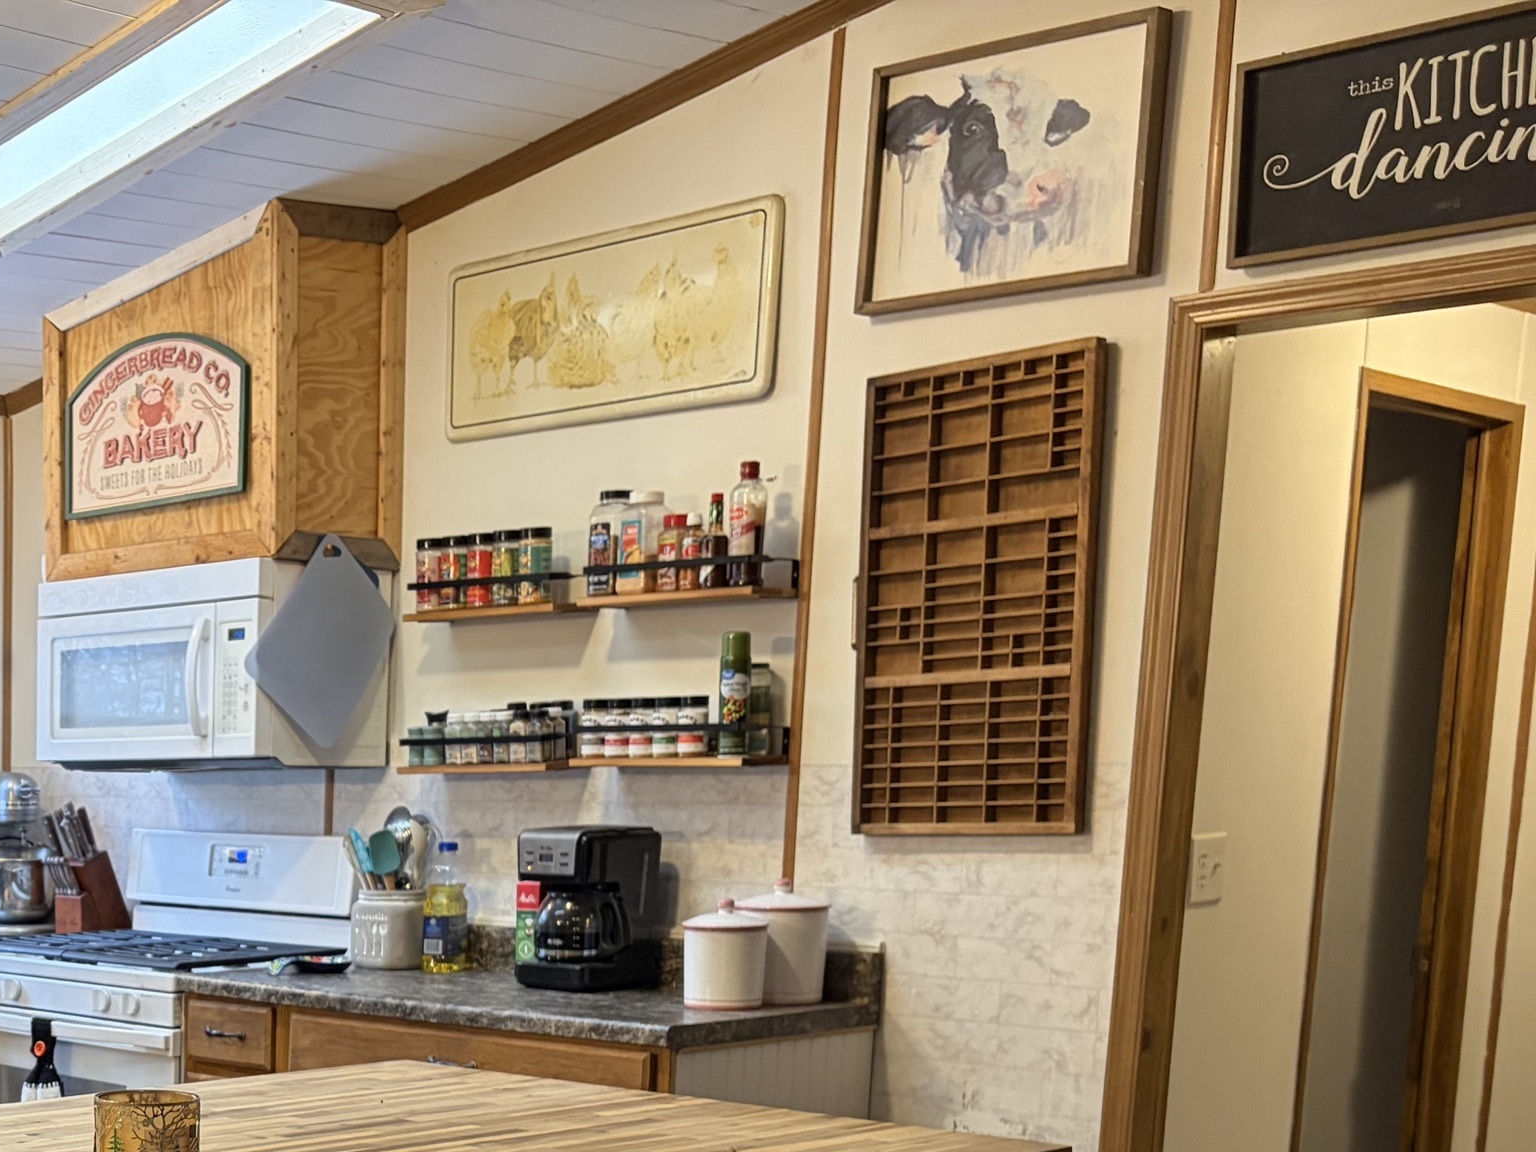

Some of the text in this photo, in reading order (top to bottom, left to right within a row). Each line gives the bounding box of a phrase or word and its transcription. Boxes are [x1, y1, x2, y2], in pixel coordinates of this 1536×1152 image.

[1347, 76, 1395, 98] this
[78, 346, 203, 426] GINGERBREAD
[102, 420, 204, 469] BAKERY
[100, 457, 203, 491] SWEETS FOR THE HOLIDAYS
